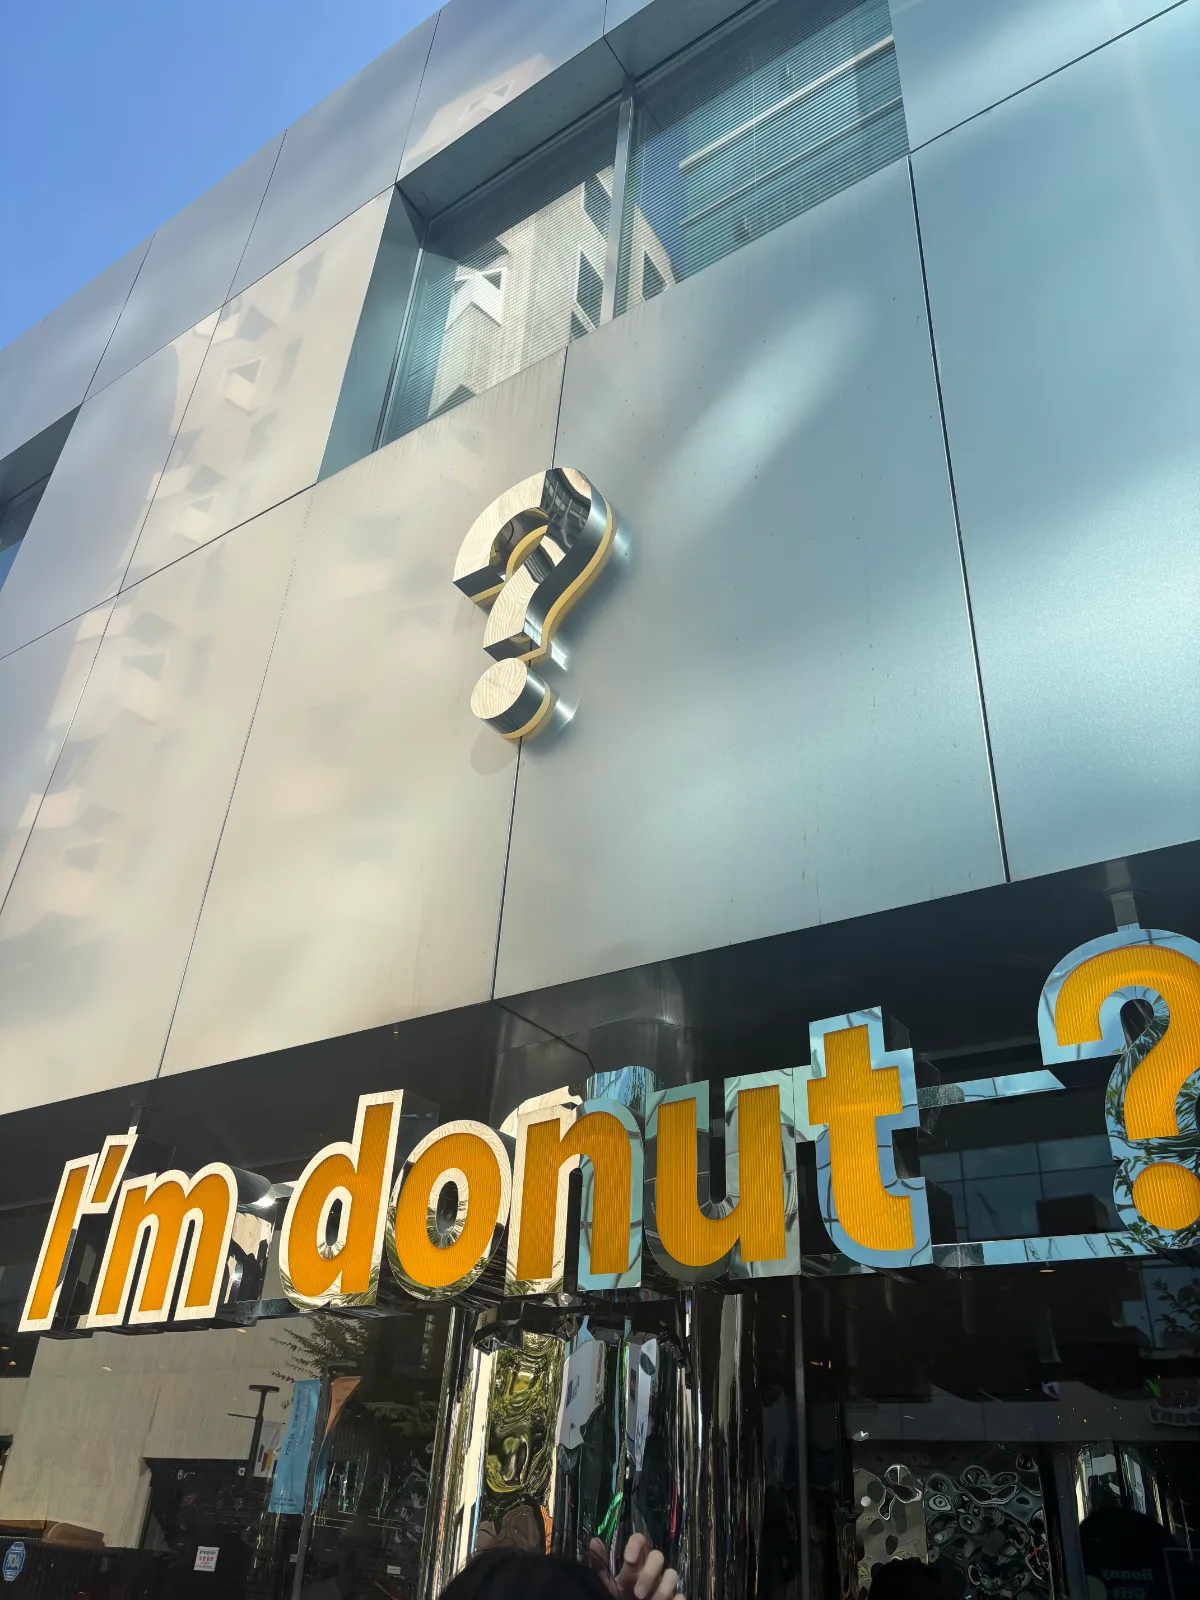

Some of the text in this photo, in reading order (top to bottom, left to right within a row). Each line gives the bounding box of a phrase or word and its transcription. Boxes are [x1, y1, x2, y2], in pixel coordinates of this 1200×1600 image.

[453, 467, 614, 740] ?
[18, 928, 1200, 1333] I'm donut ?
